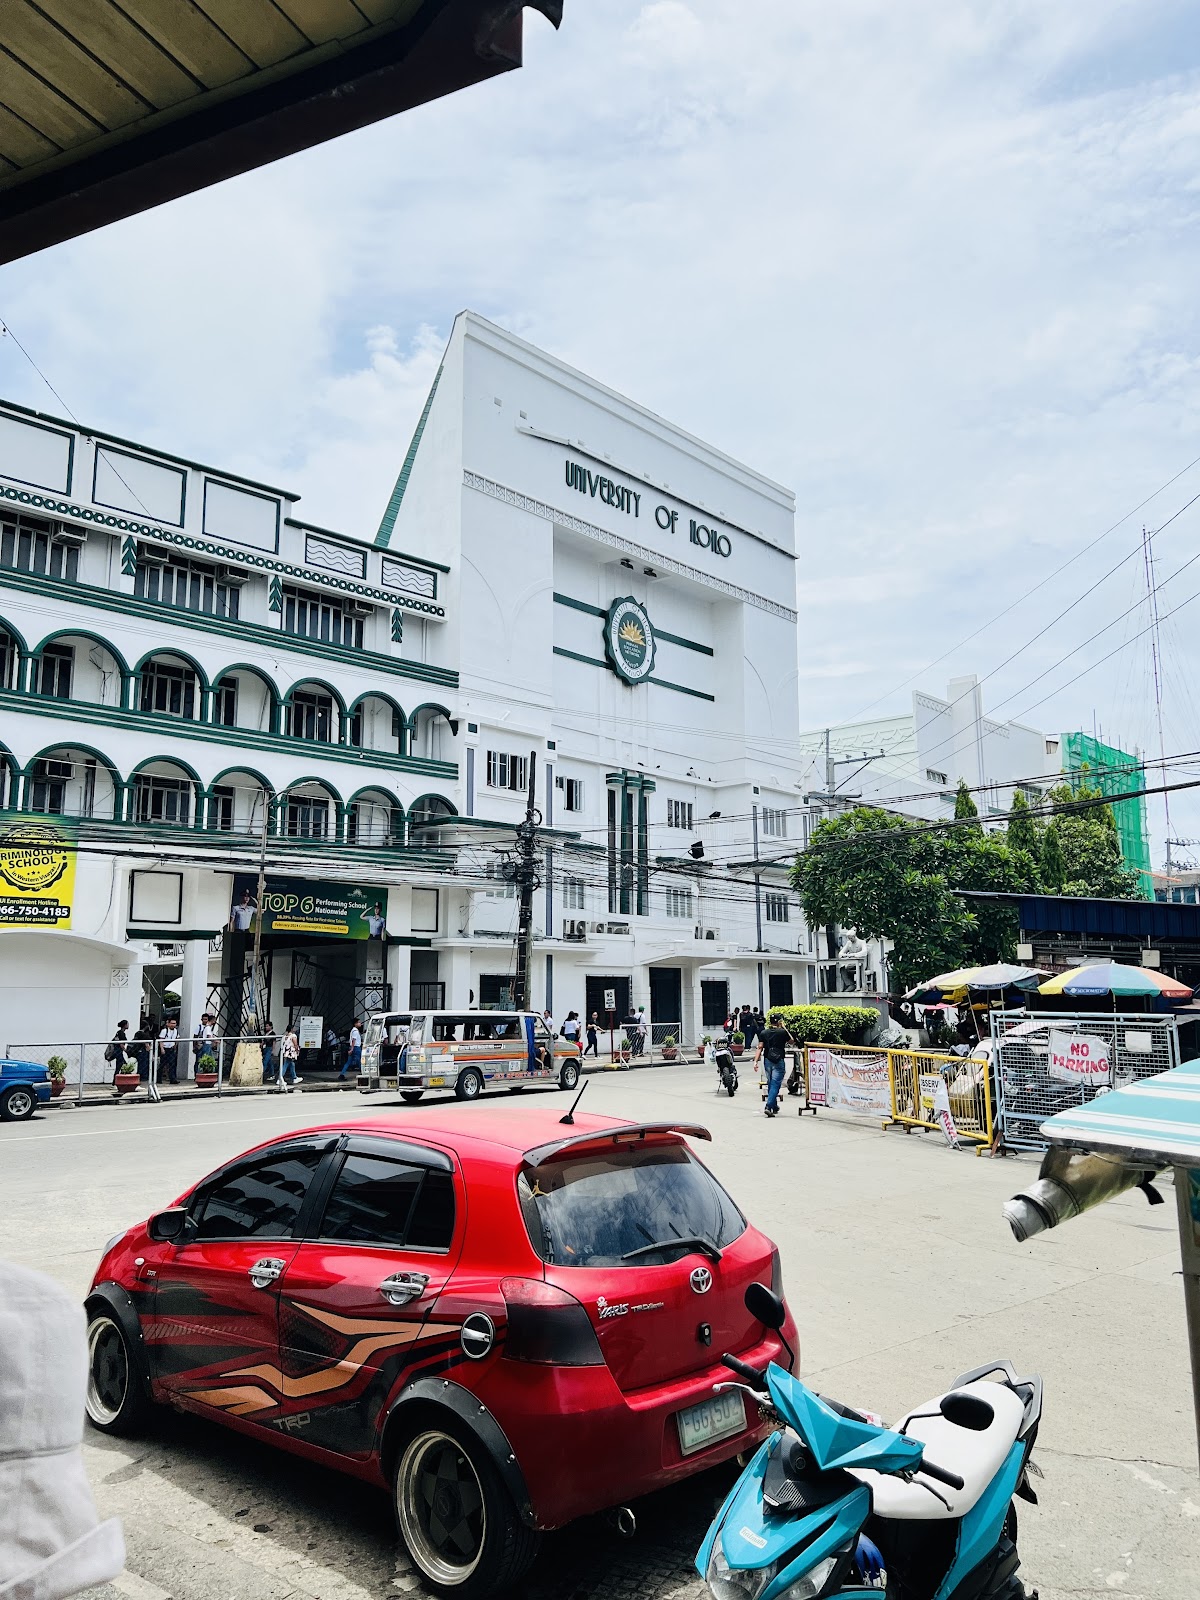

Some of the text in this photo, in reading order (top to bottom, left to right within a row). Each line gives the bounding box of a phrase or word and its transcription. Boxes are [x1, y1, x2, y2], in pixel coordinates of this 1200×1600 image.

[565, 459, 732, 558] UNIVERSITY OF ILOILO
[8, 855, 57, 869] SCHOOL
[17, 873, 40, 883] Western
[262, 892, 315, 914] TOP 6
[315, 898, 368, 910] Performing School
[0, 905, 69, 917] 66-750-4185
[314, 906, 348, 917] Nationwide
[1070, 1043, 1090, 1057] NO
[1053, 1053, 1109, 1074] PARKING
[920, 1078, 940, 1089] BSERV
[598, 1303, 629, 1319] YARIS
[272, 1411, 311, 1432] TRD
